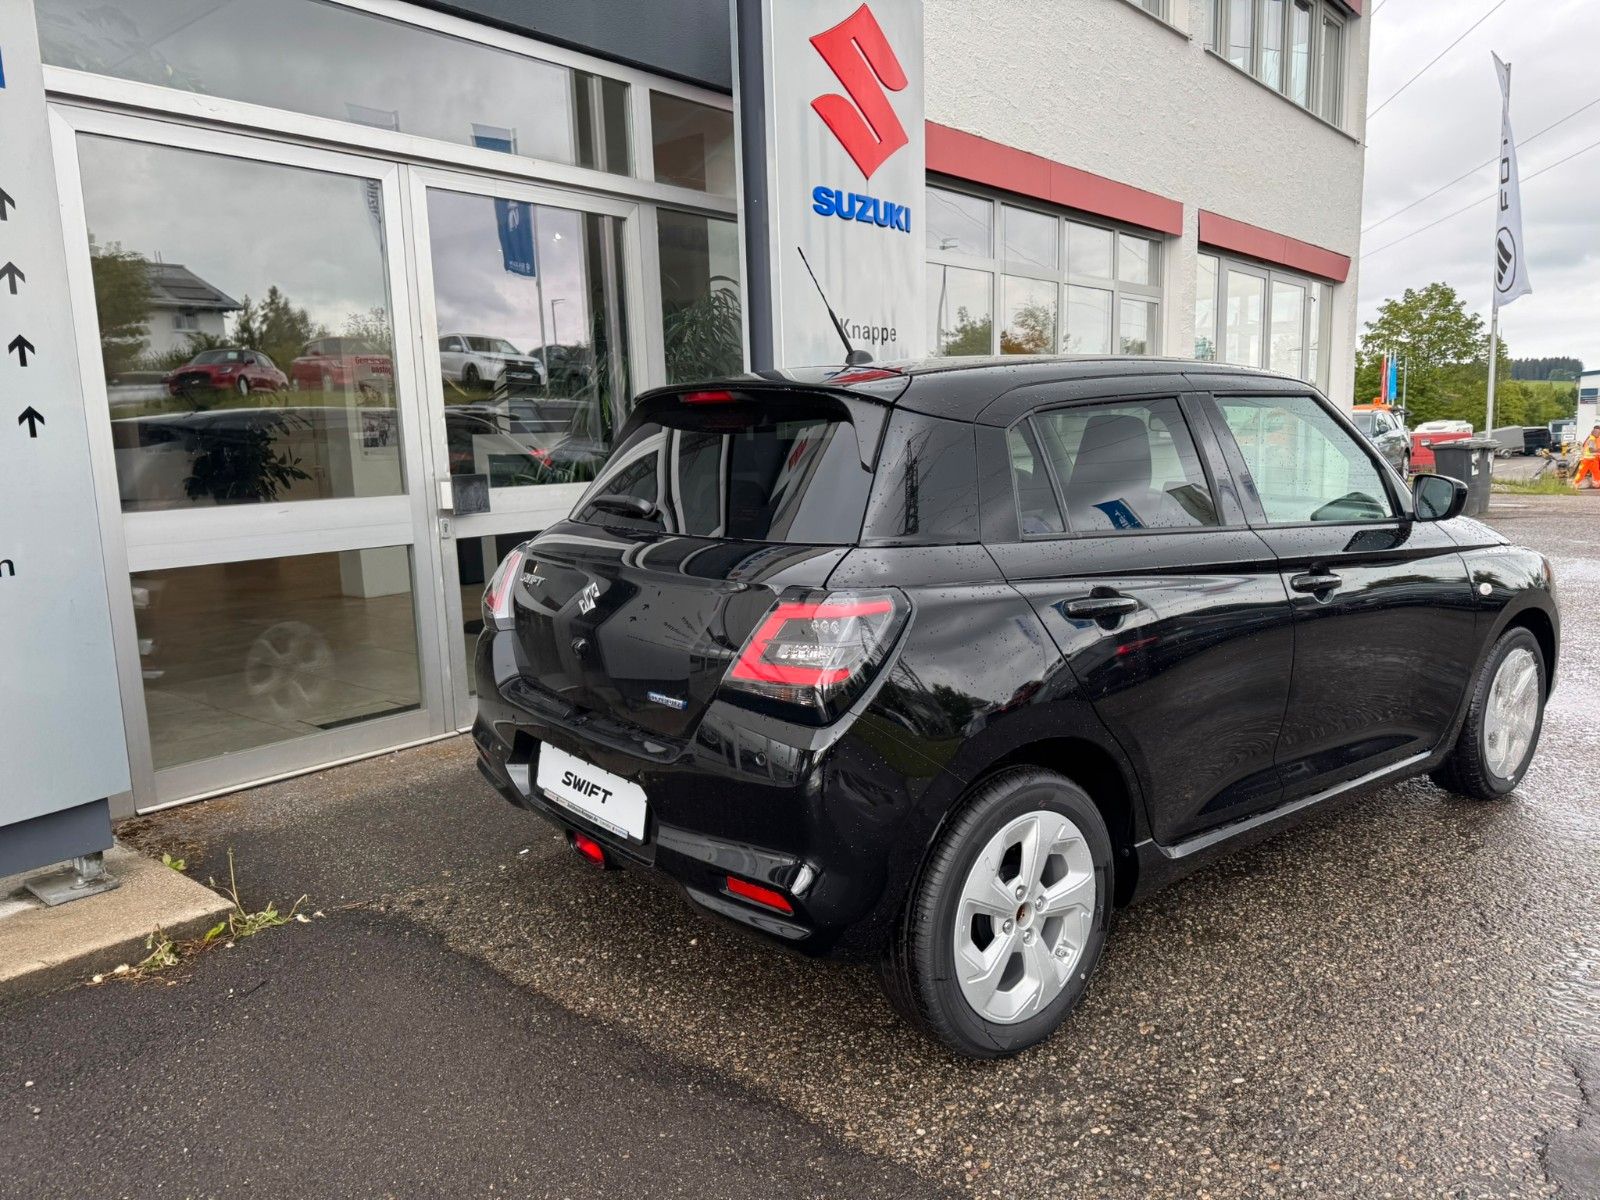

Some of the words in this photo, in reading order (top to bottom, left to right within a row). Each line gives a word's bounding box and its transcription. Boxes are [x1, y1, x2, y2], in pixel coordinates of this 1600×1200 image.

[812, 186, 911, 233] SUZUKI
[840, 318, 897, 346] Knappe
[561, 770, 613, 804] SWIFT
